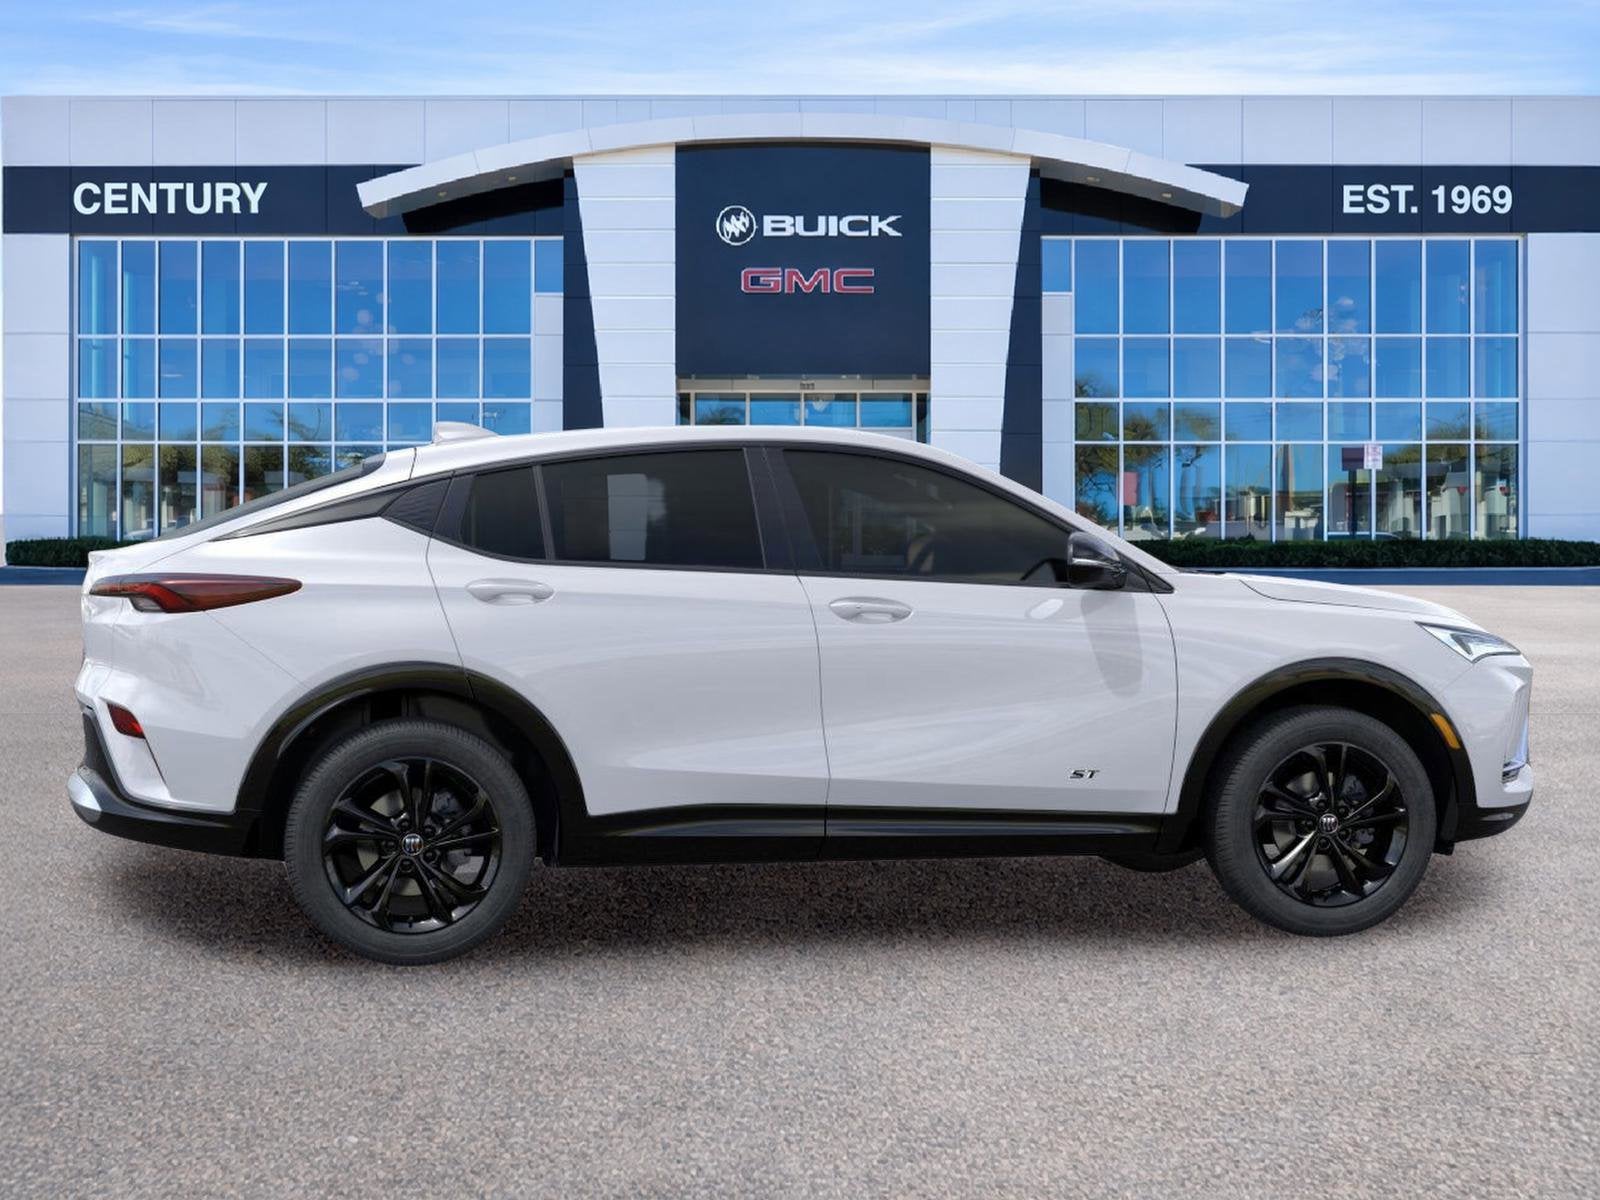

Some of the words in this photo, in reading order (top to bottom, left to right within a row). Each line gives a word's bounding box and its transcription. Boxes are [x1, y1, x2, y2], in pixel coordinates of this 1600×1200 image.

[73, 181, 268, 215] CENTURY
[1343, 184, 1418, 214] EST.
[1432, 184, 1513, 214] 1969
[763, 215, 903, 237] BUICK
[741, 267, 875, 294] GMC
[1070, 769, 1100, 779] ST
